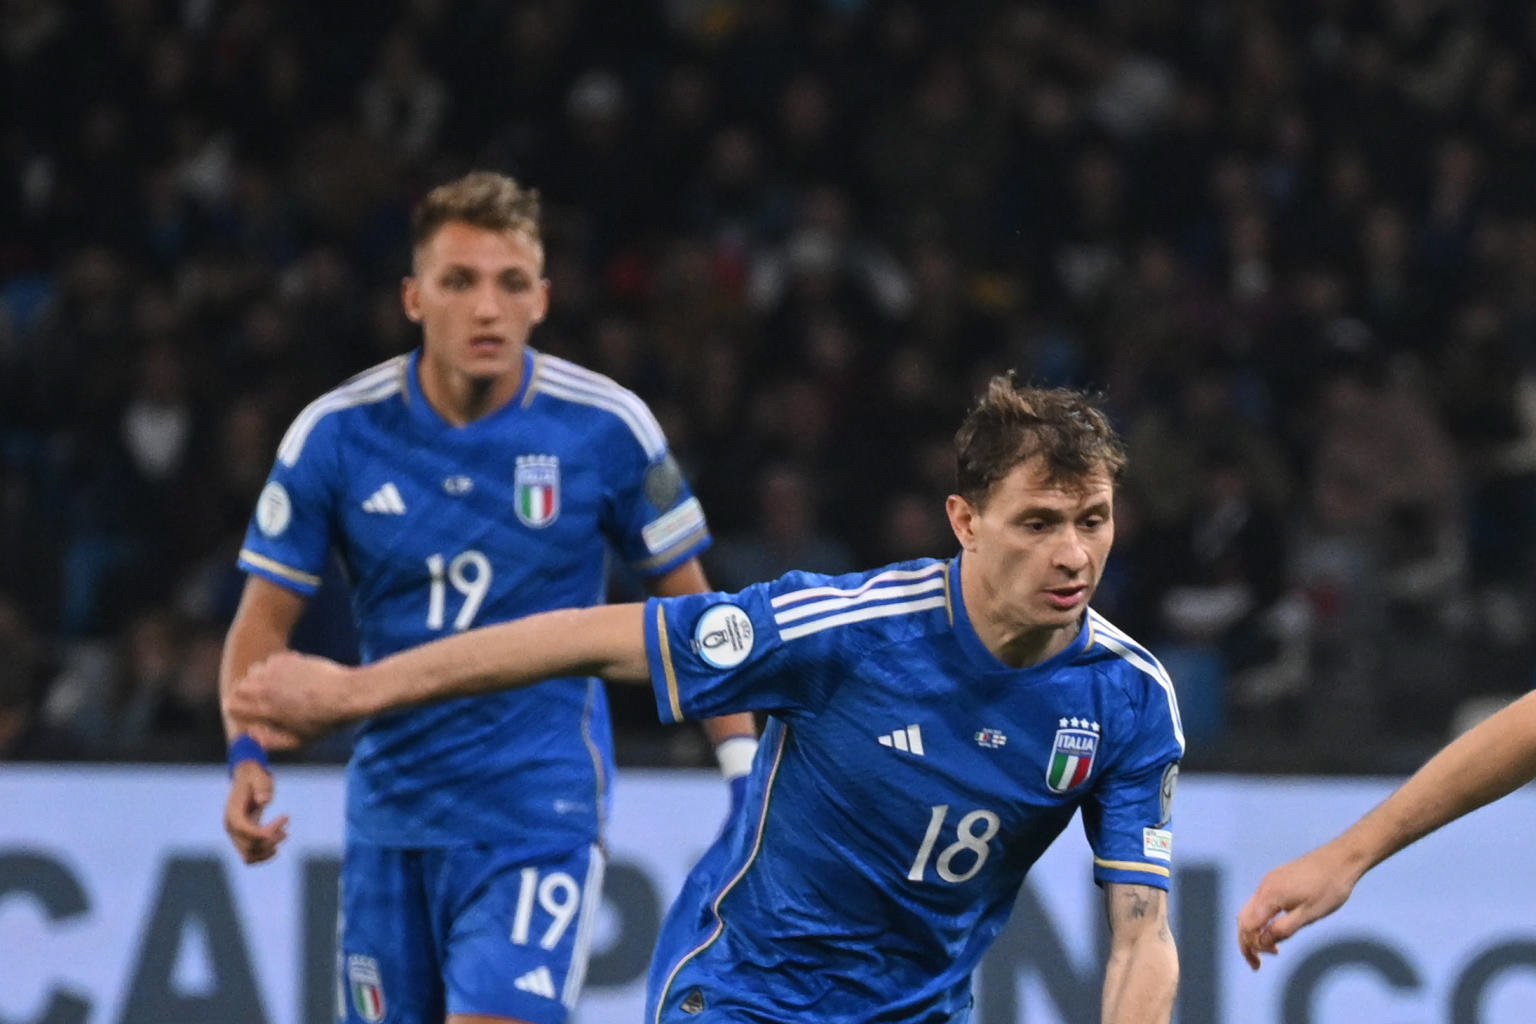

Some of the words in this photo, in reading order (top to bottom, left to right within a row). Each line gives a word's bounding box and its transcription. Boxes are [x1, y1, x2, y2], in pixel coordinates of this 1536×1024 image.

[425, 549, 493, 632] 19
[1057, 733, 1095, 752] ITALIA
[907, 803, 1001, 884] 18
[511, 866, 580, 951] 19
